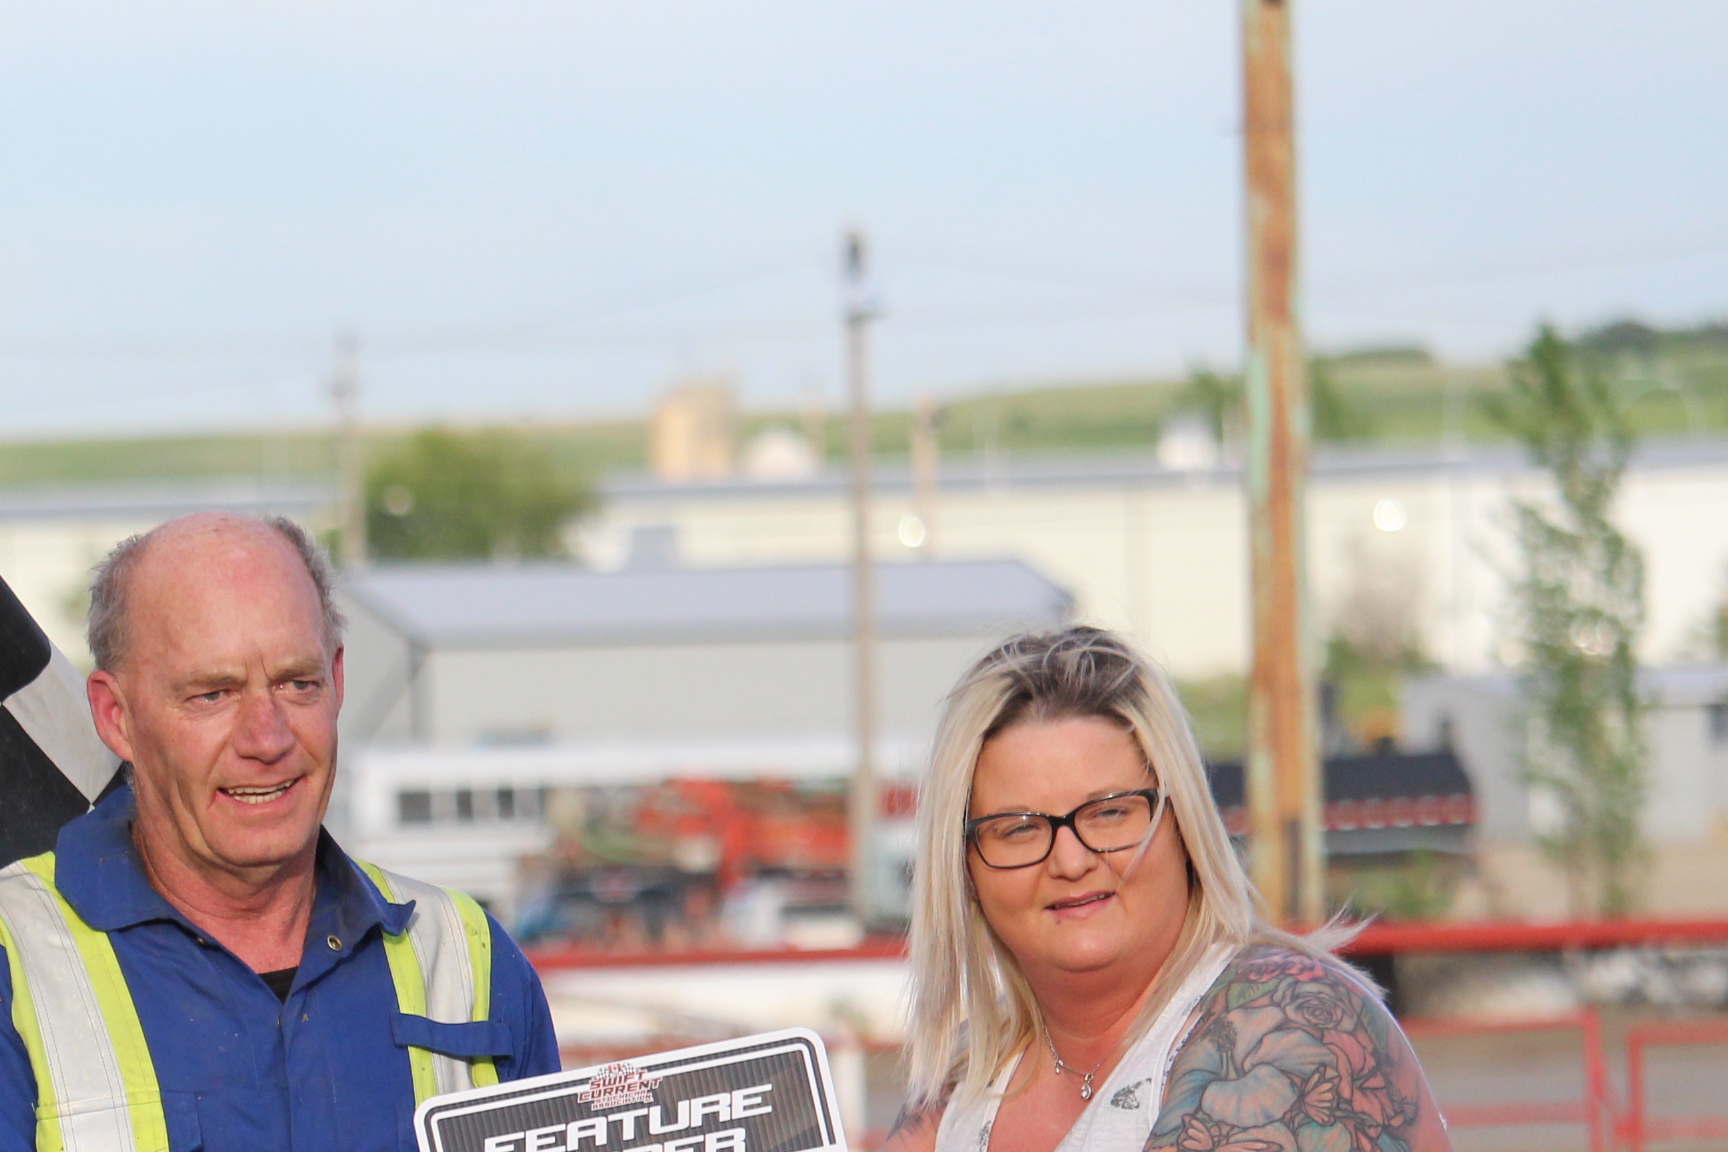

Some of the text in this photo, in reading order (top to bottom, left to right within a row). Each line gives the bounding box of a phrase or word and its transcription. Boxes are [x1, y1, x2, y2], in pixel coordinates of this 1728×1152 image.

[578, 1077, 663, 1103] CURRENT
[590, 1070, 647, 1090] SWIFT
[591, 1093, 654, 1110] ASSOCIATION
